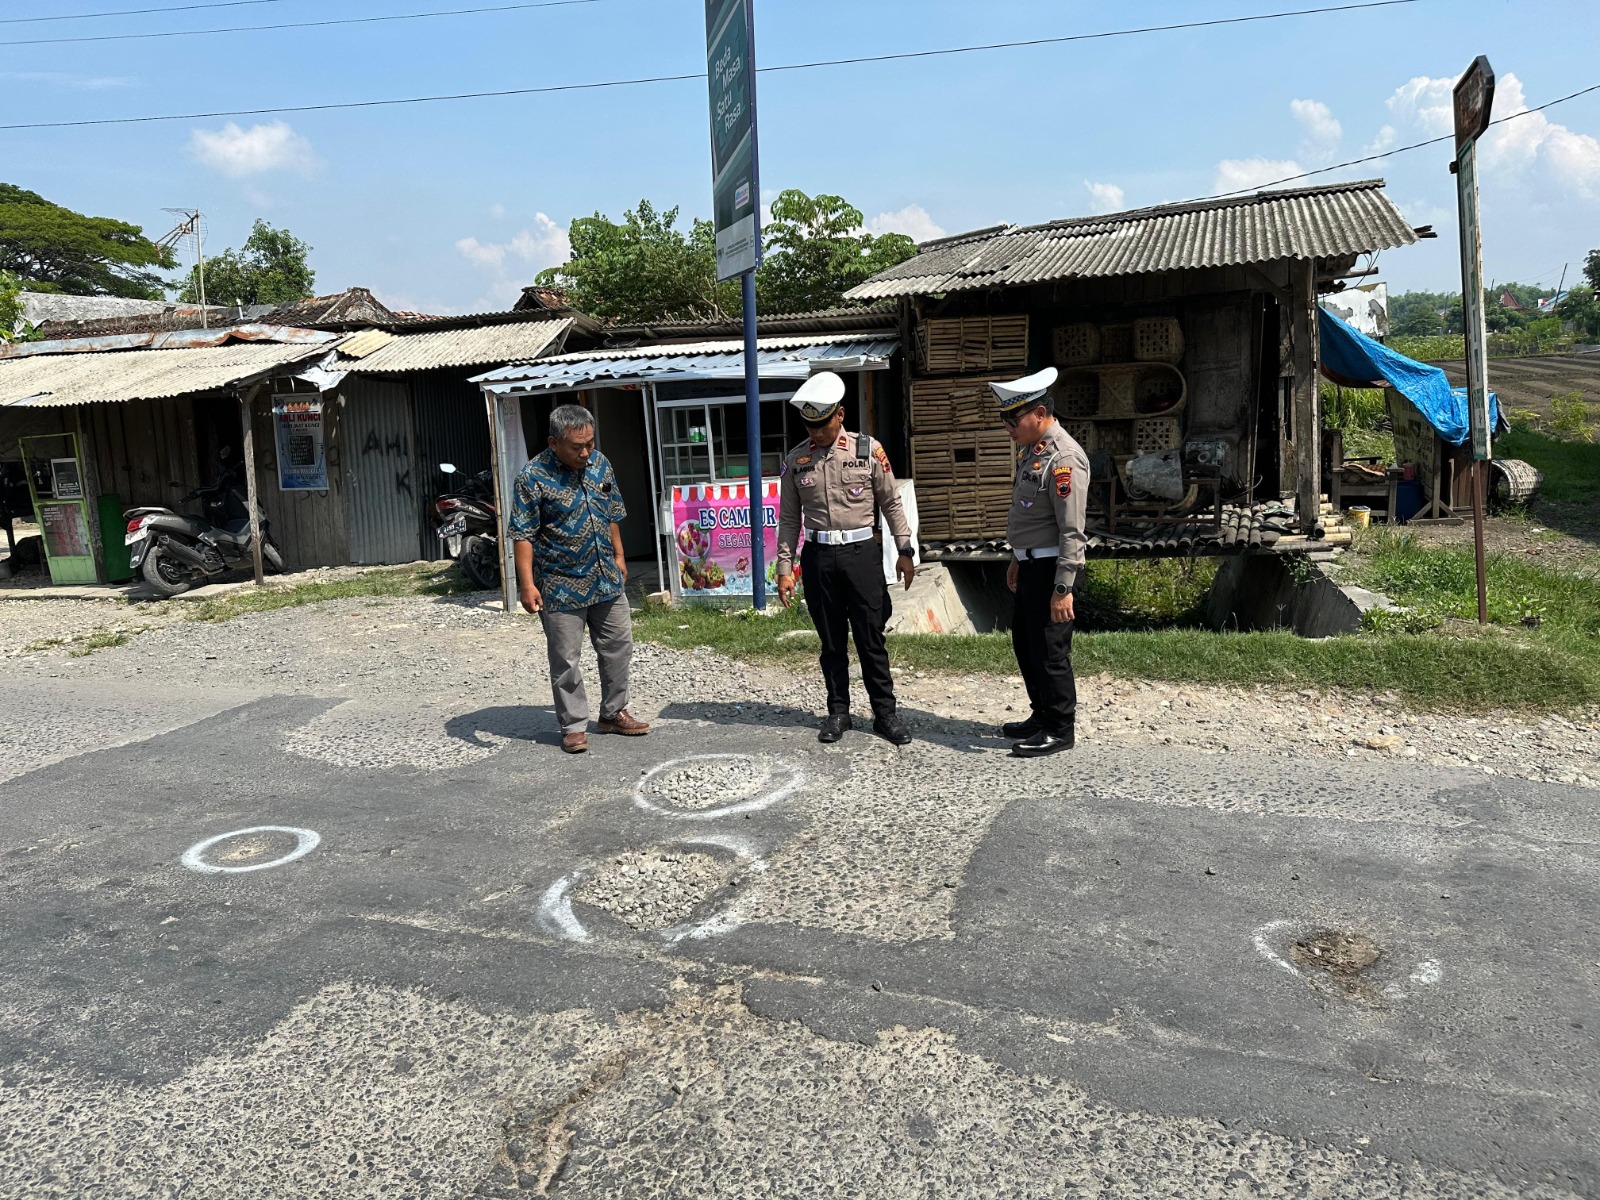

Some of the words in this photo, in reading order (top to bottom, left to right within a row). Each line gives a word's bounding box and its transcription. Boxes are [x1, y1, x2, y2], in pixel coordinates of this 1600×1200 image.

[715, 45, 731, 80] Beda
[722, 56, 740, 92] Masa
[717, 90, 732, 121] Satu
[724, 102, 740, 133] Rasa
[699, 509, 716, 527] ES
[719, 507, 777, 527] CAMR
